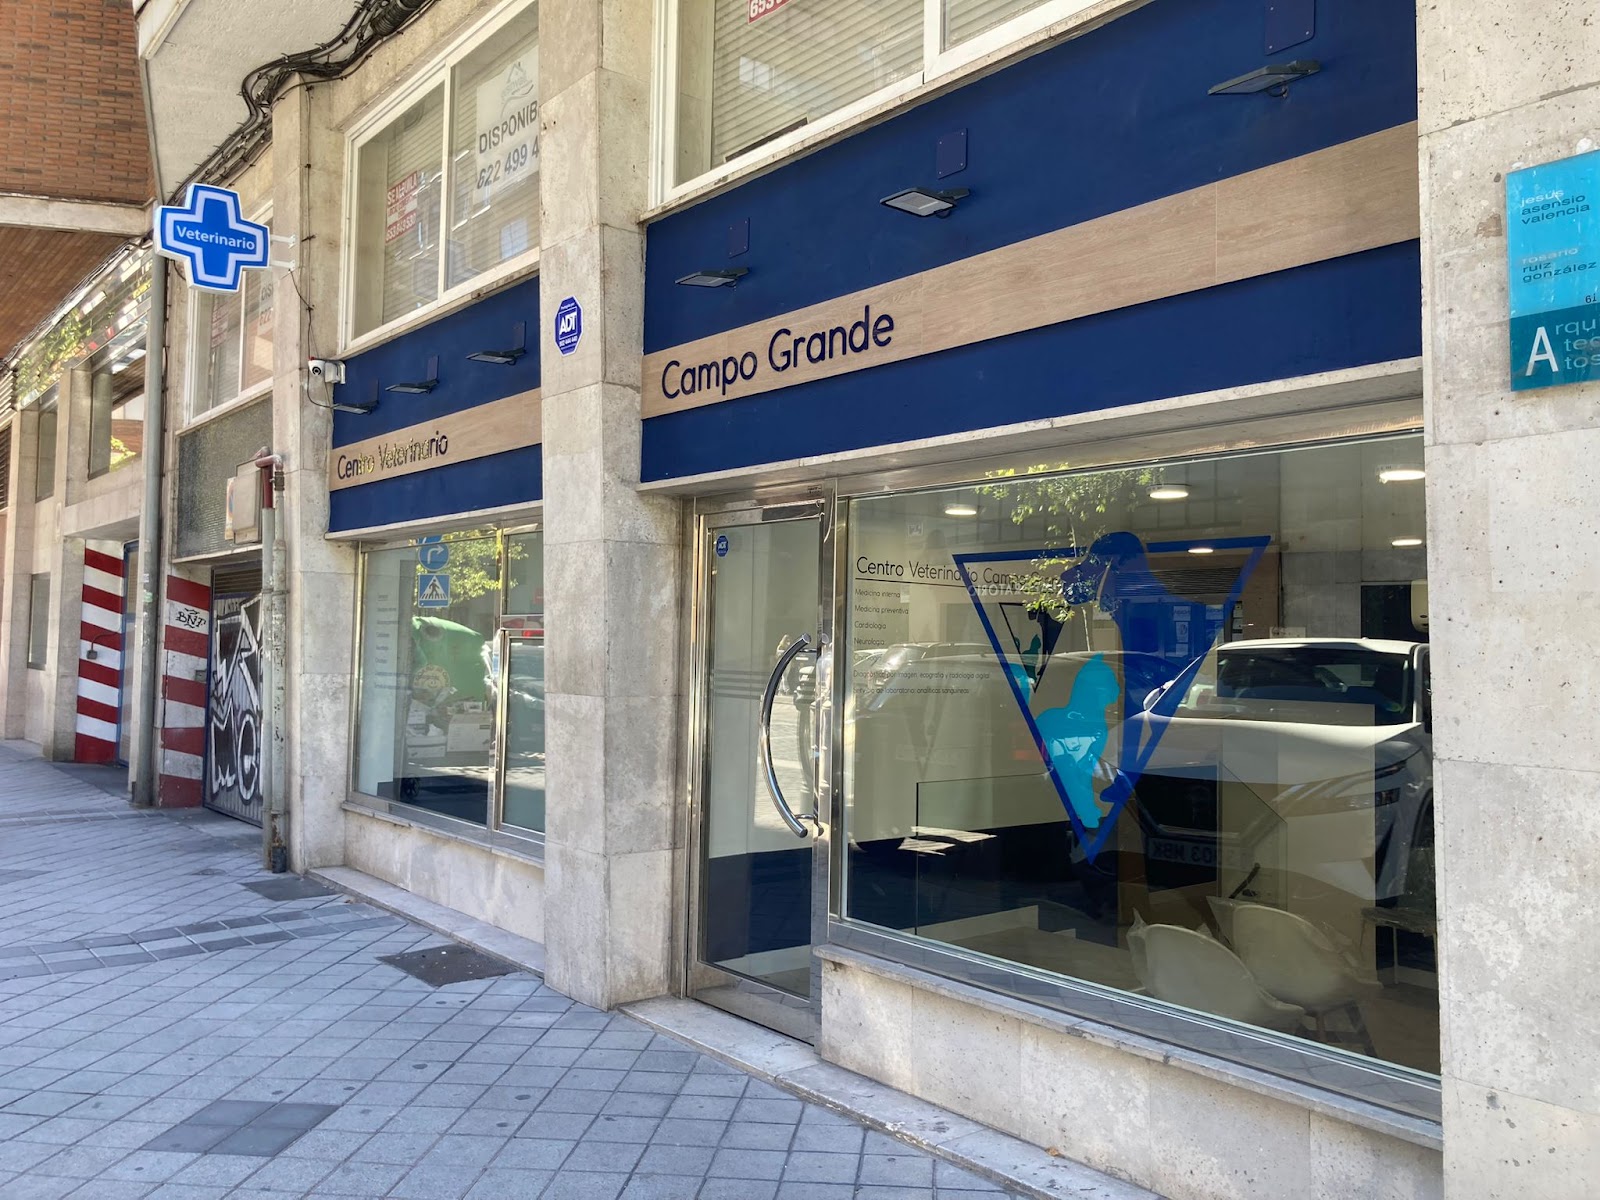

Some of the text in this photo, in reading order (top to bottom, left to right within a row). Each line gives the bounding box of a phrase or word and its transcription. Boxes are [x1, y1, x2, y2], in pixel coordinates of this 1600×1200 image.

[479, 101, 538, 154] DISPONIB
[477, 160, 501, 189] 622
[504, 144, 528, 176] 499
[1521, 194, 1587, 216] asensio
[1521, 203, 1591, 226] valencia
[176, 225, 255, 250] Veterinario
[1522, 248, 1580, 265] rosario
[1522, 261, 1552, 274] ruiz
[1522, 260, 1597, 284] gonzález
[559, 311, 577, 335] ADT
[661, 305, 894, 399] Campo Grande
[337, 430, 448, 480] Centro Veterinario
[856, 556, 904, 577] Centro
[908, 560, 979, 583] Veterinaio
